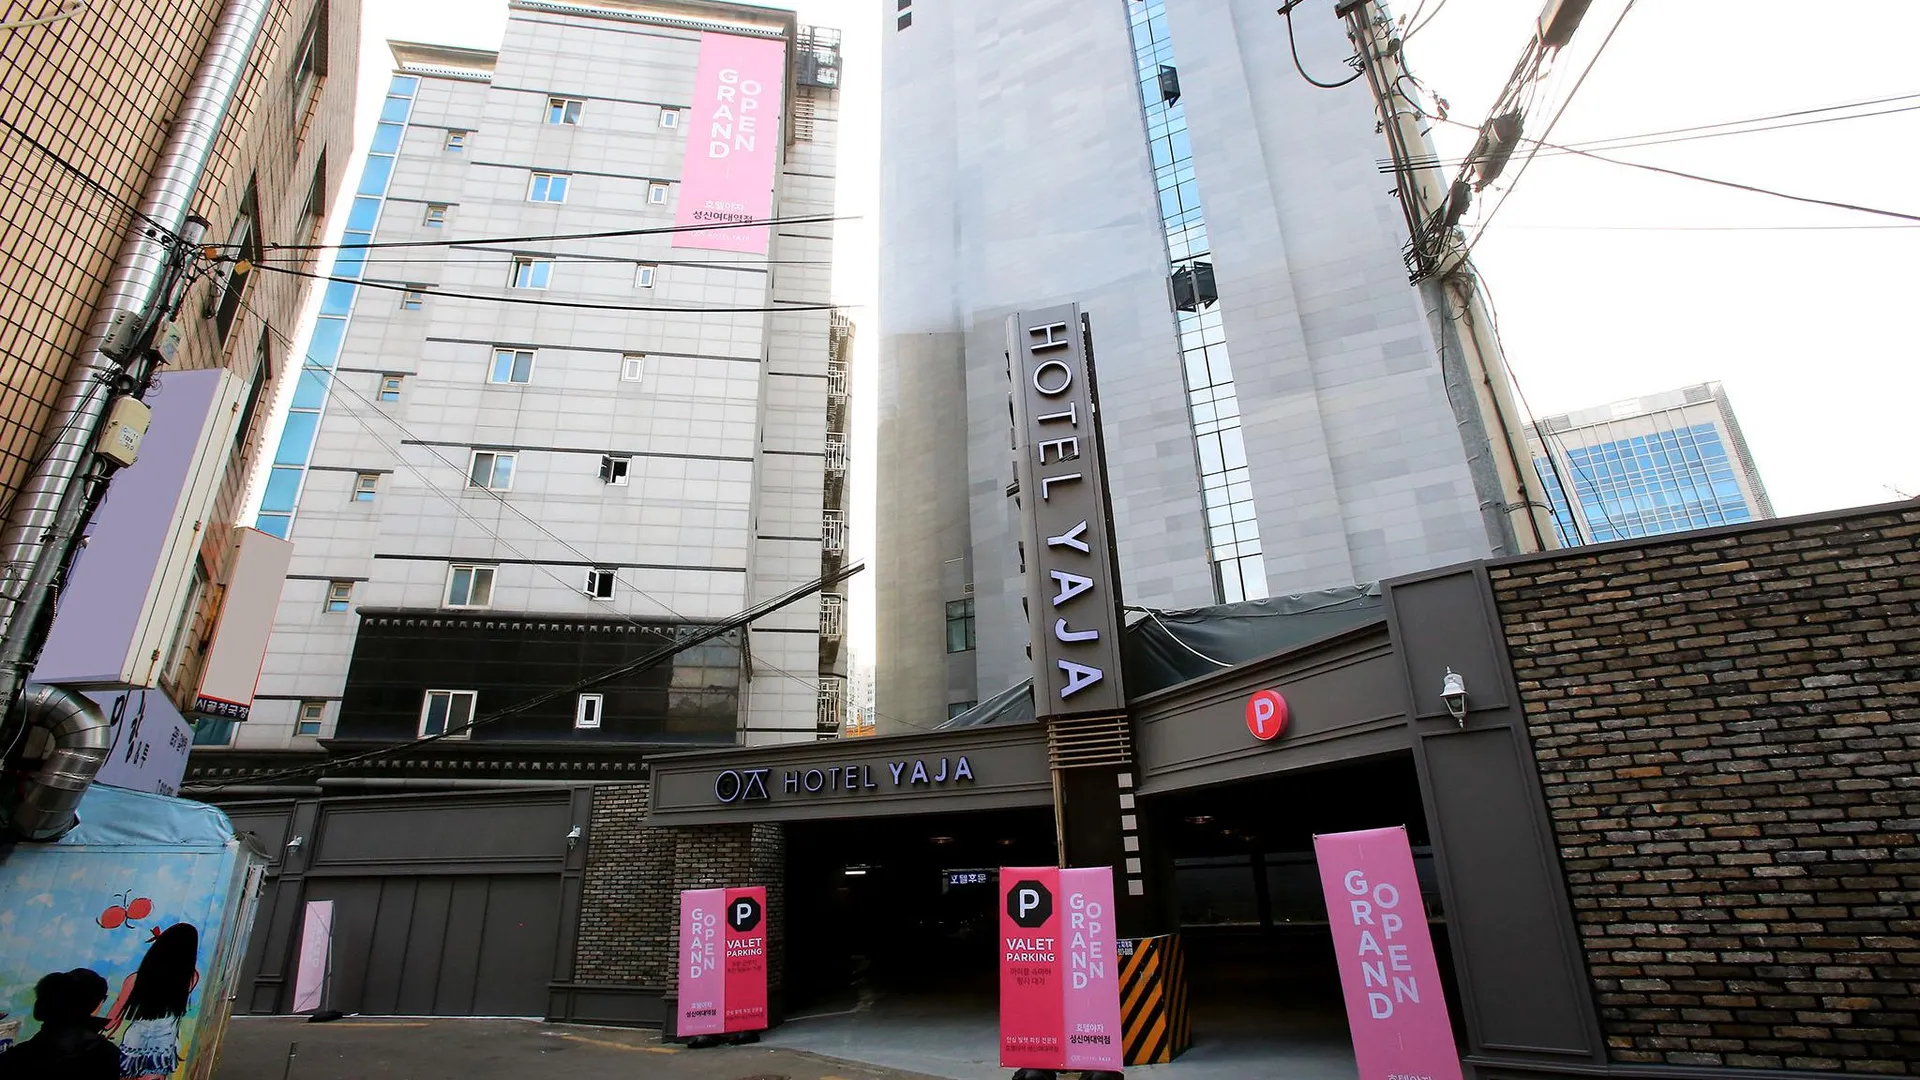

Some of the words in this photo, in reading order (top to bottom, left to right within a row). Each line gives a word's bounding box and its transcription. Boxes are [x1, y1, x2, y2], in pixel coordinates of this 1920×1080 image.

[709, 68, 740, 159] GRAND
[734, 80, 761, 152] OPEN
[1028, 320, 1082, 500] HOTEL
[1047, 520, 1104, 700] YAJA
[196, 698, 249, 719] 시골청국장
[1254, 697, 1275, 734] P
[784, 764, 877, 793] HOTEL
[889, 756, 975, 785] YAJA
[736, 903, 752, 926] P
[1019, 888, 1040, 919] P
[691, 908, 703, 979] GRAND
[704, 914, 716, 970] OPEN
[726, 948, 762, 958] PARKING
[727, 938, 762, 949] VALET
[1006, 938, 1054, 951] VALET
[1006, 953, 1055, 962] PARKING
[1069, 893, 1089, 990] GRAND
[1086, 902, 1105, 979] OPEN
[1344, 869, 1394, 1019] GRAND
[1373, 883, 1420, 1004] OPEN
[1070, 1034, 1110, 1044] 성신여대역점
